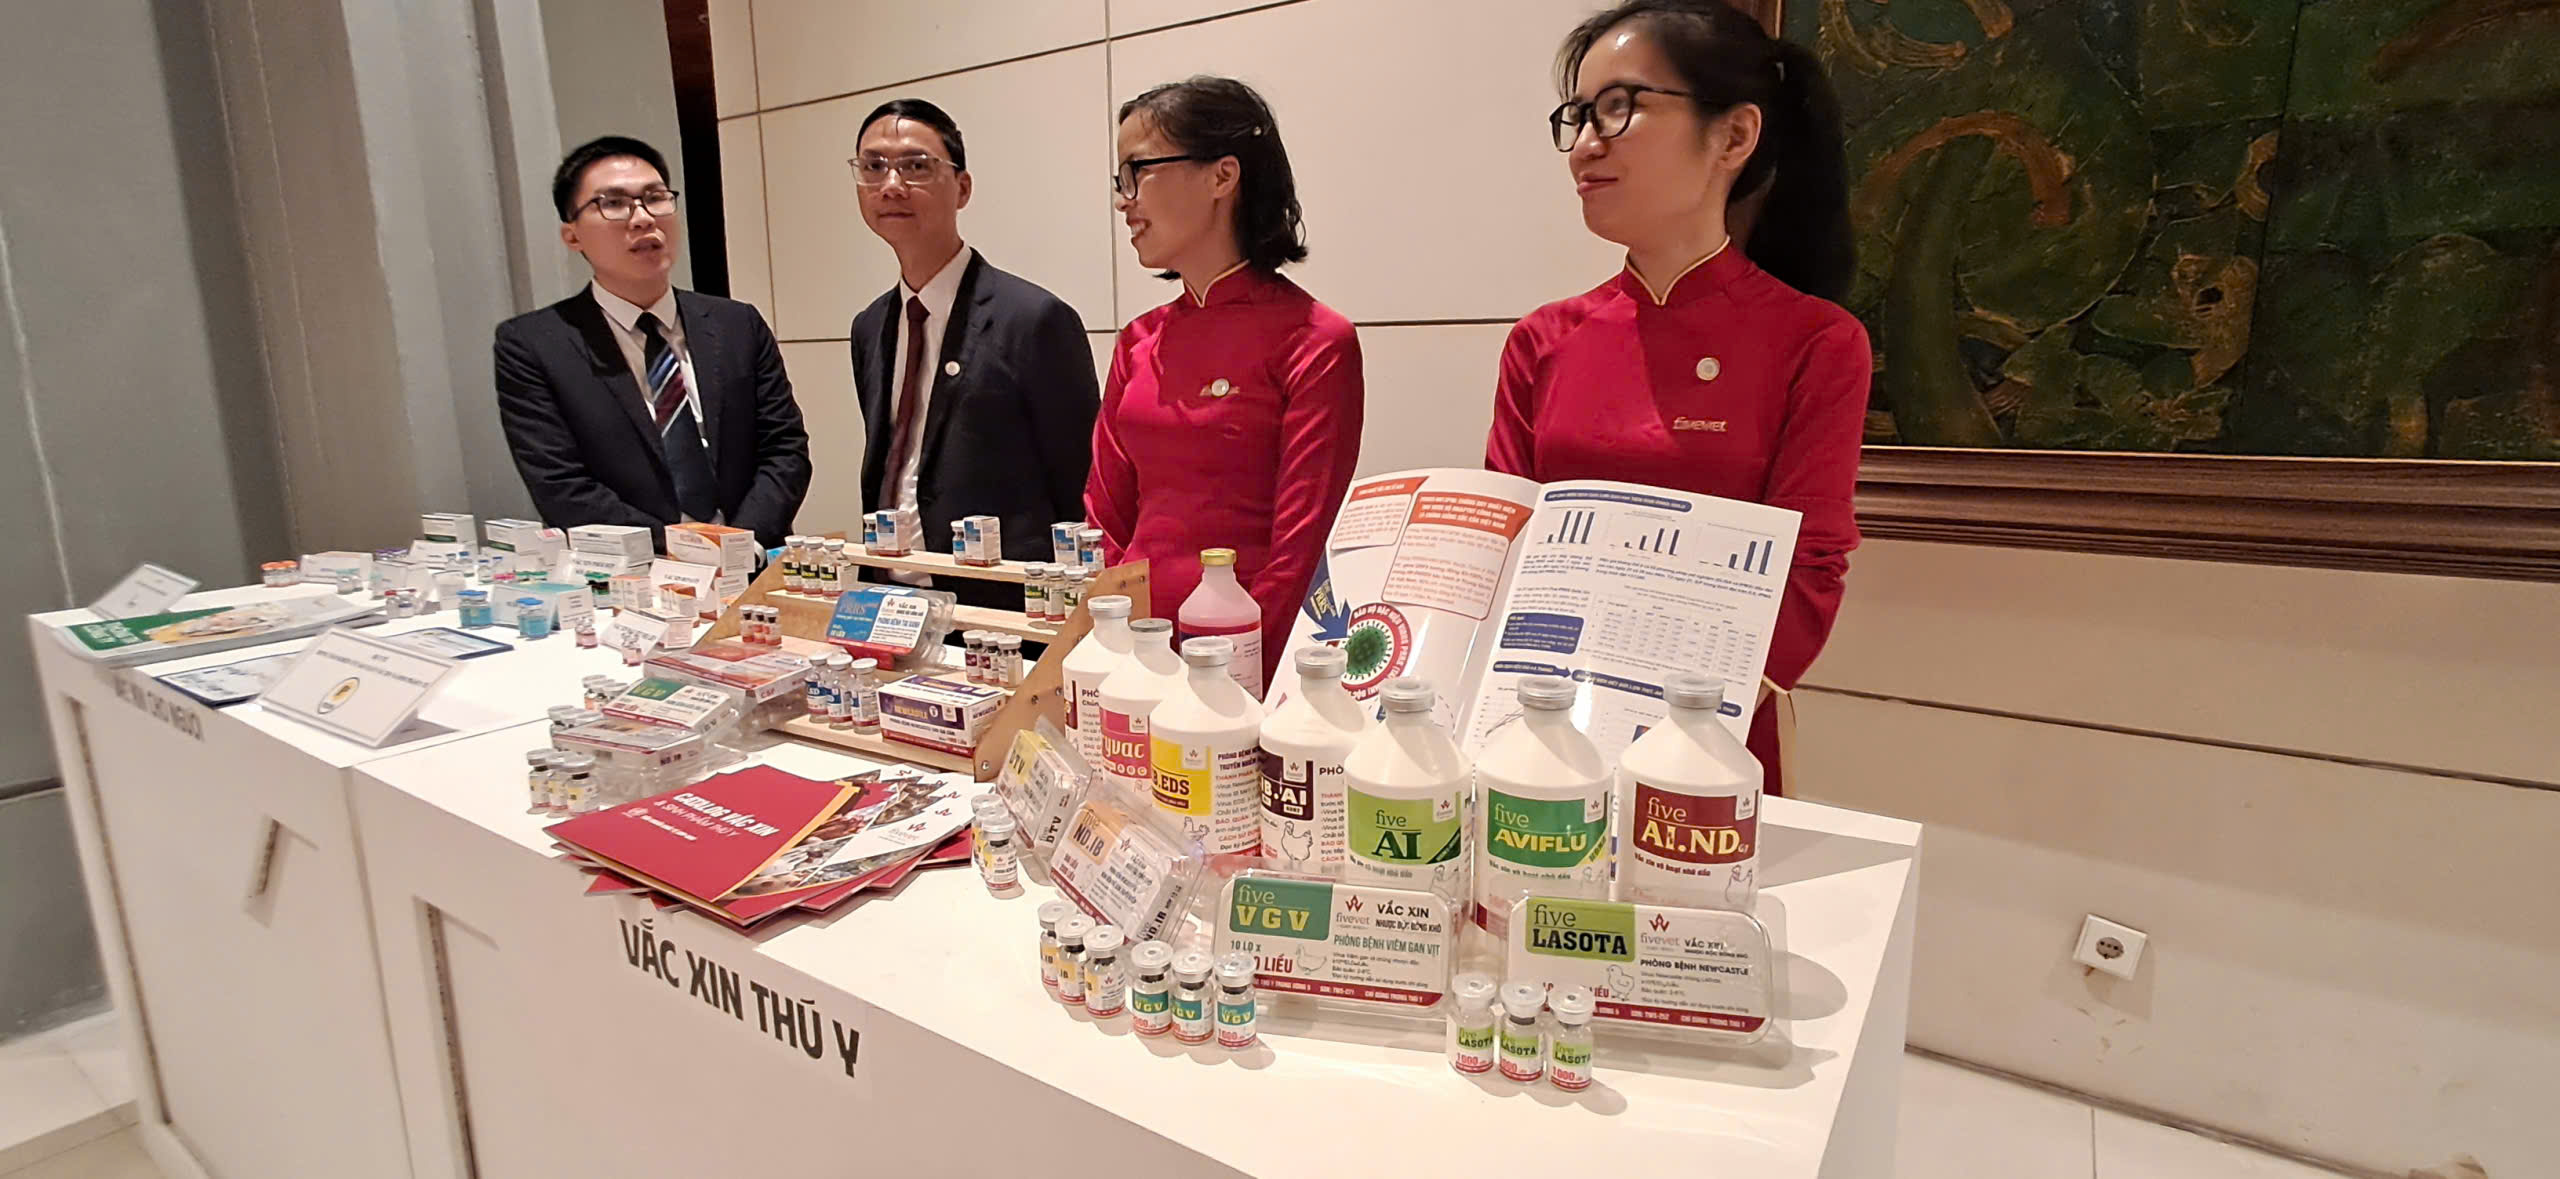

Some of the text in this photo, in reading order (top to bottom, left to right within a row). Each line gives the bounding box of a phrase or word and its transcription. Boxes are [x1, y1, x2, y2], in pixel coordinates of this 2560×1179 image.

[1319, 763, 1345, 776] PHÒ
[1375, 809, 1407, 829] five
[1493, 803, 1530, 829] five
[1647, 796, 1688, 823] five
[1371, 830, 1423, 860] AI
[1494, 827, 1588, 853] AVIFLU
[1239, 884, 1276, 905] five
[1377, 900, 1430, 918] VẮC XIN
[1534, 904, 1577, 928] five
[1231, 940, 1241, 951] 10
[1408, 942, 1425, 954] GAN
[1532, 928, 1628, 955] LASOTA
[1640, 958, 1749, 976] PHÒNG BỆNH NEWCASTLE
[685, 949, 744, 1022] XIN
[832, 1019, 860, 1078] Y
[1221, 1012, 1251, 1024] VGV
